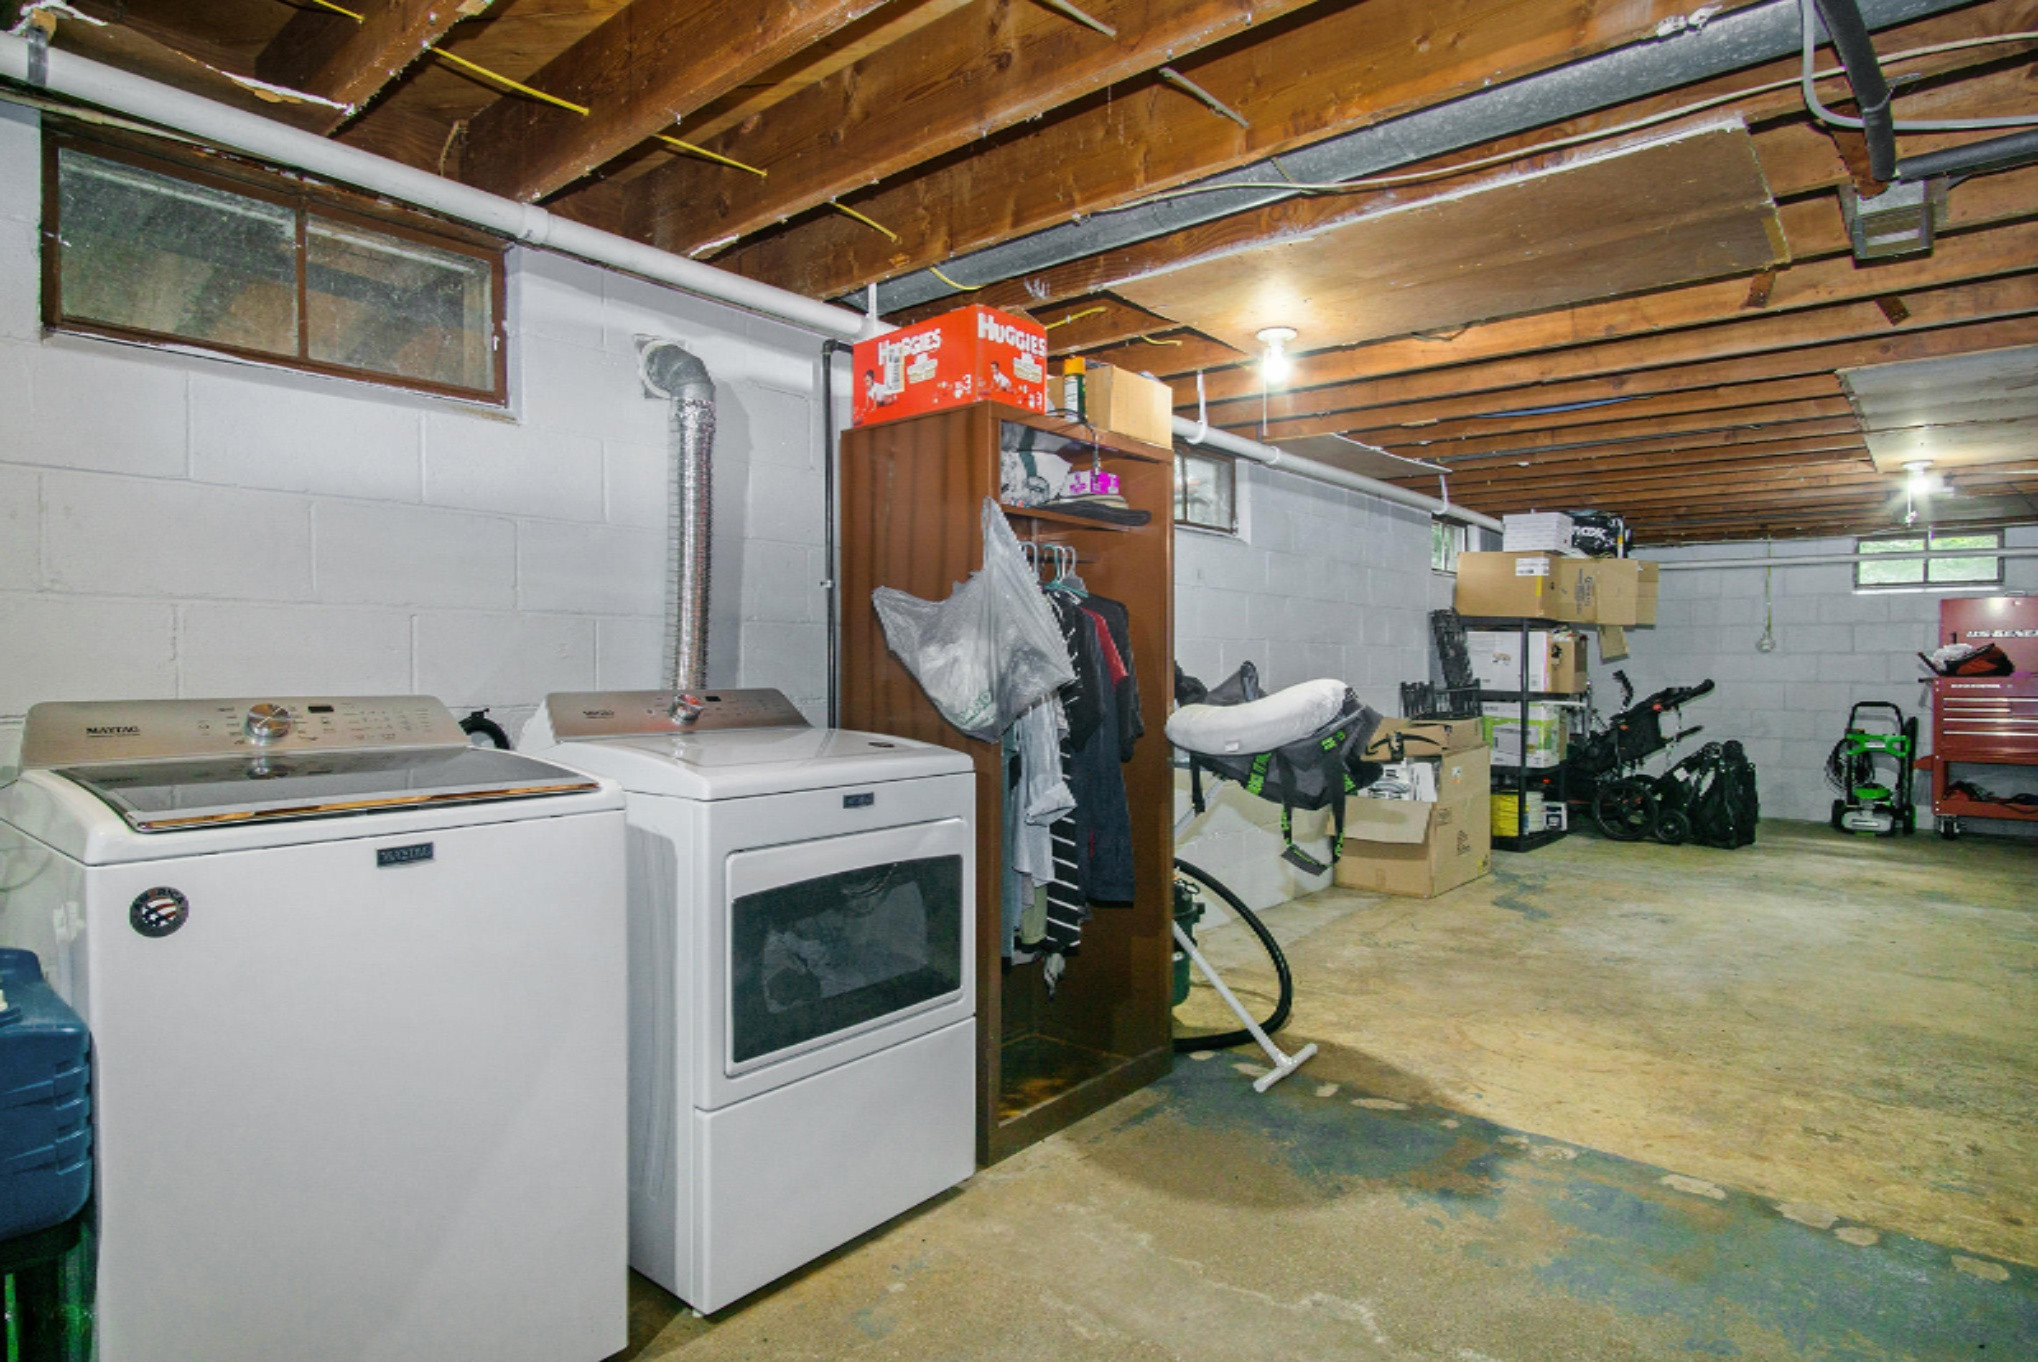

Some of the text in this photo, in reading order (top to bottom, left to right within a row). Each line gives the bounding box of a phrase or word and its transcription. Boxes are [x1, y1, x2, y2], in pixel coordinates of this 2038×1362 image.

[878, 328, 941, 366] HGGIES
[977, 312, 1046, 357] HUGGIES
[86, 725, 140, 735] MAYTAG
